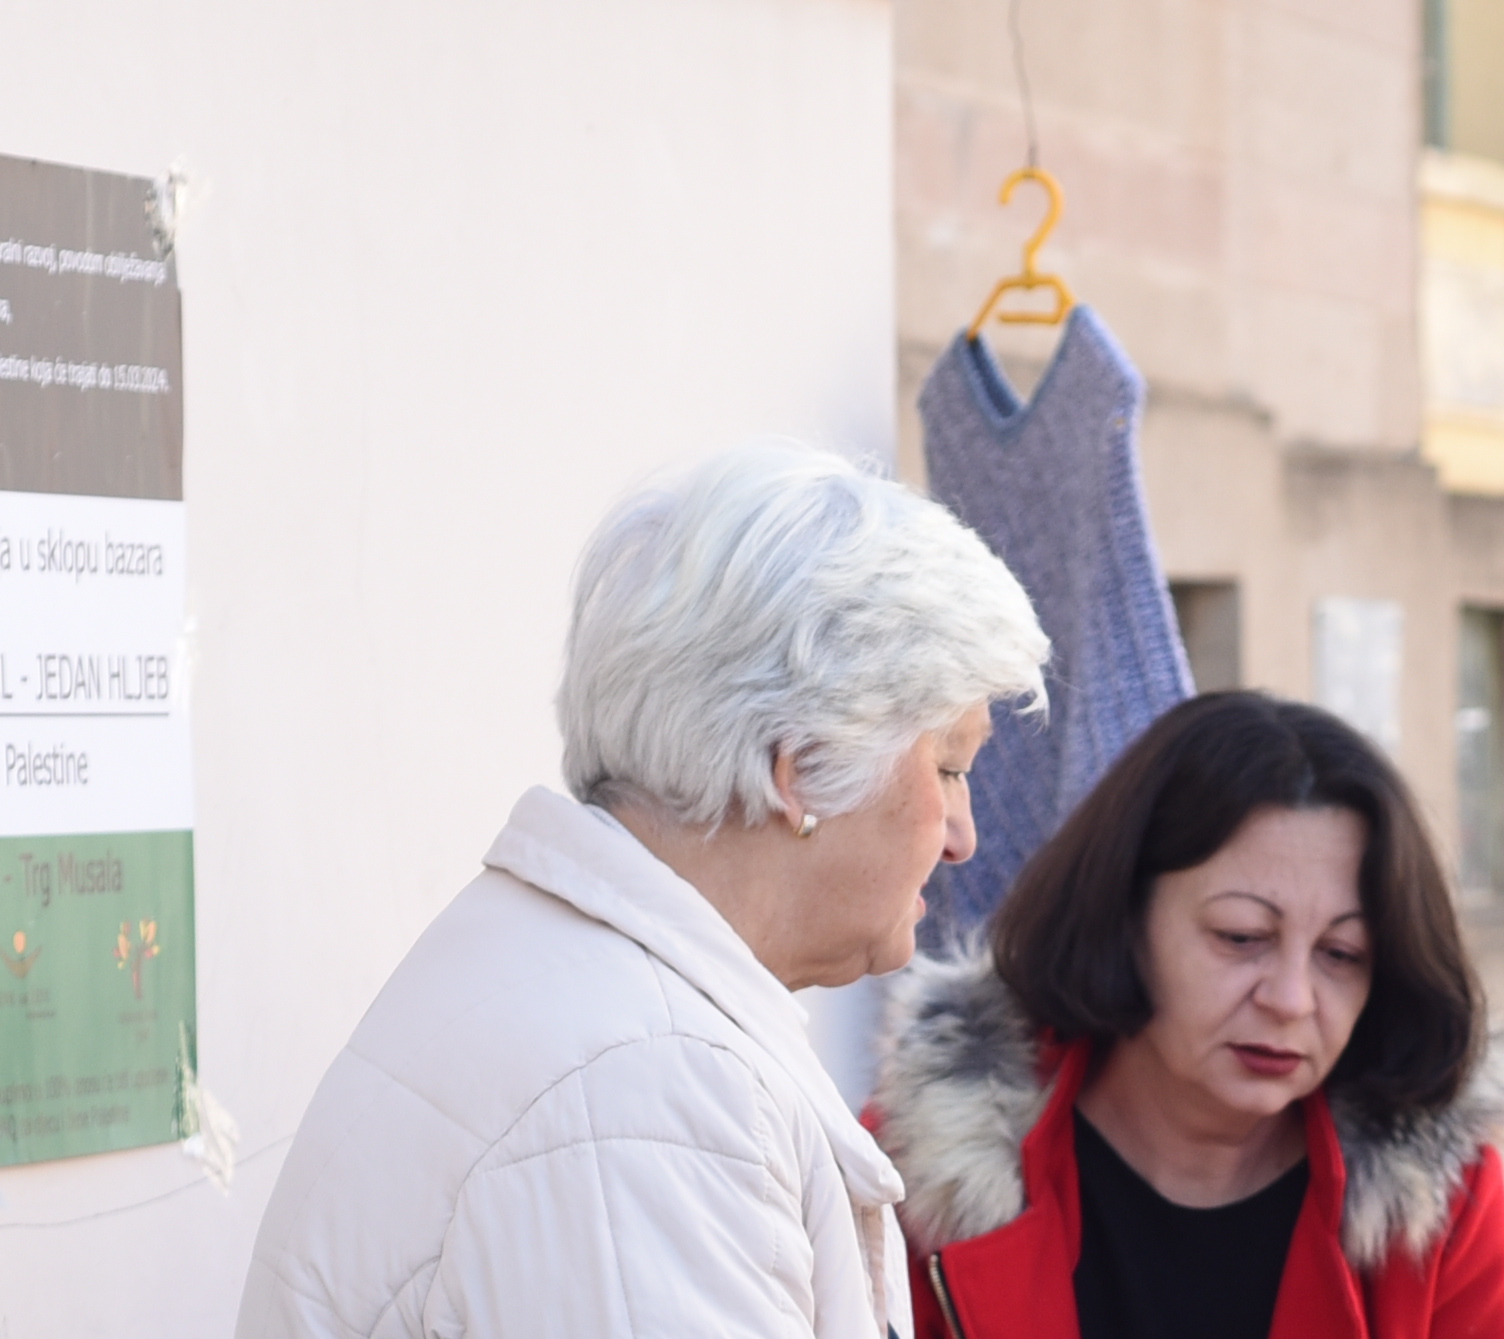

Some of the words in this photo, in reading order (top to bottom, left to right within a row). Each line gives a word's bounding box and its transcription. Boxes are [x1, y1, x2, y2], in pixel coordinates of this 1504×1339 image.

[19, 534, 32, 572] u
[37, 522, 99, 585] sklopu
[103, 528, 165, 578] bazara
[35, 653, 103, 701] JEDAN
[108, 654, 170, 701] HLJEB
[4, 740, 89, 788] Palestine
[21, 854, 52, 907] Trg
[58, 850, 124, 896] Musala
